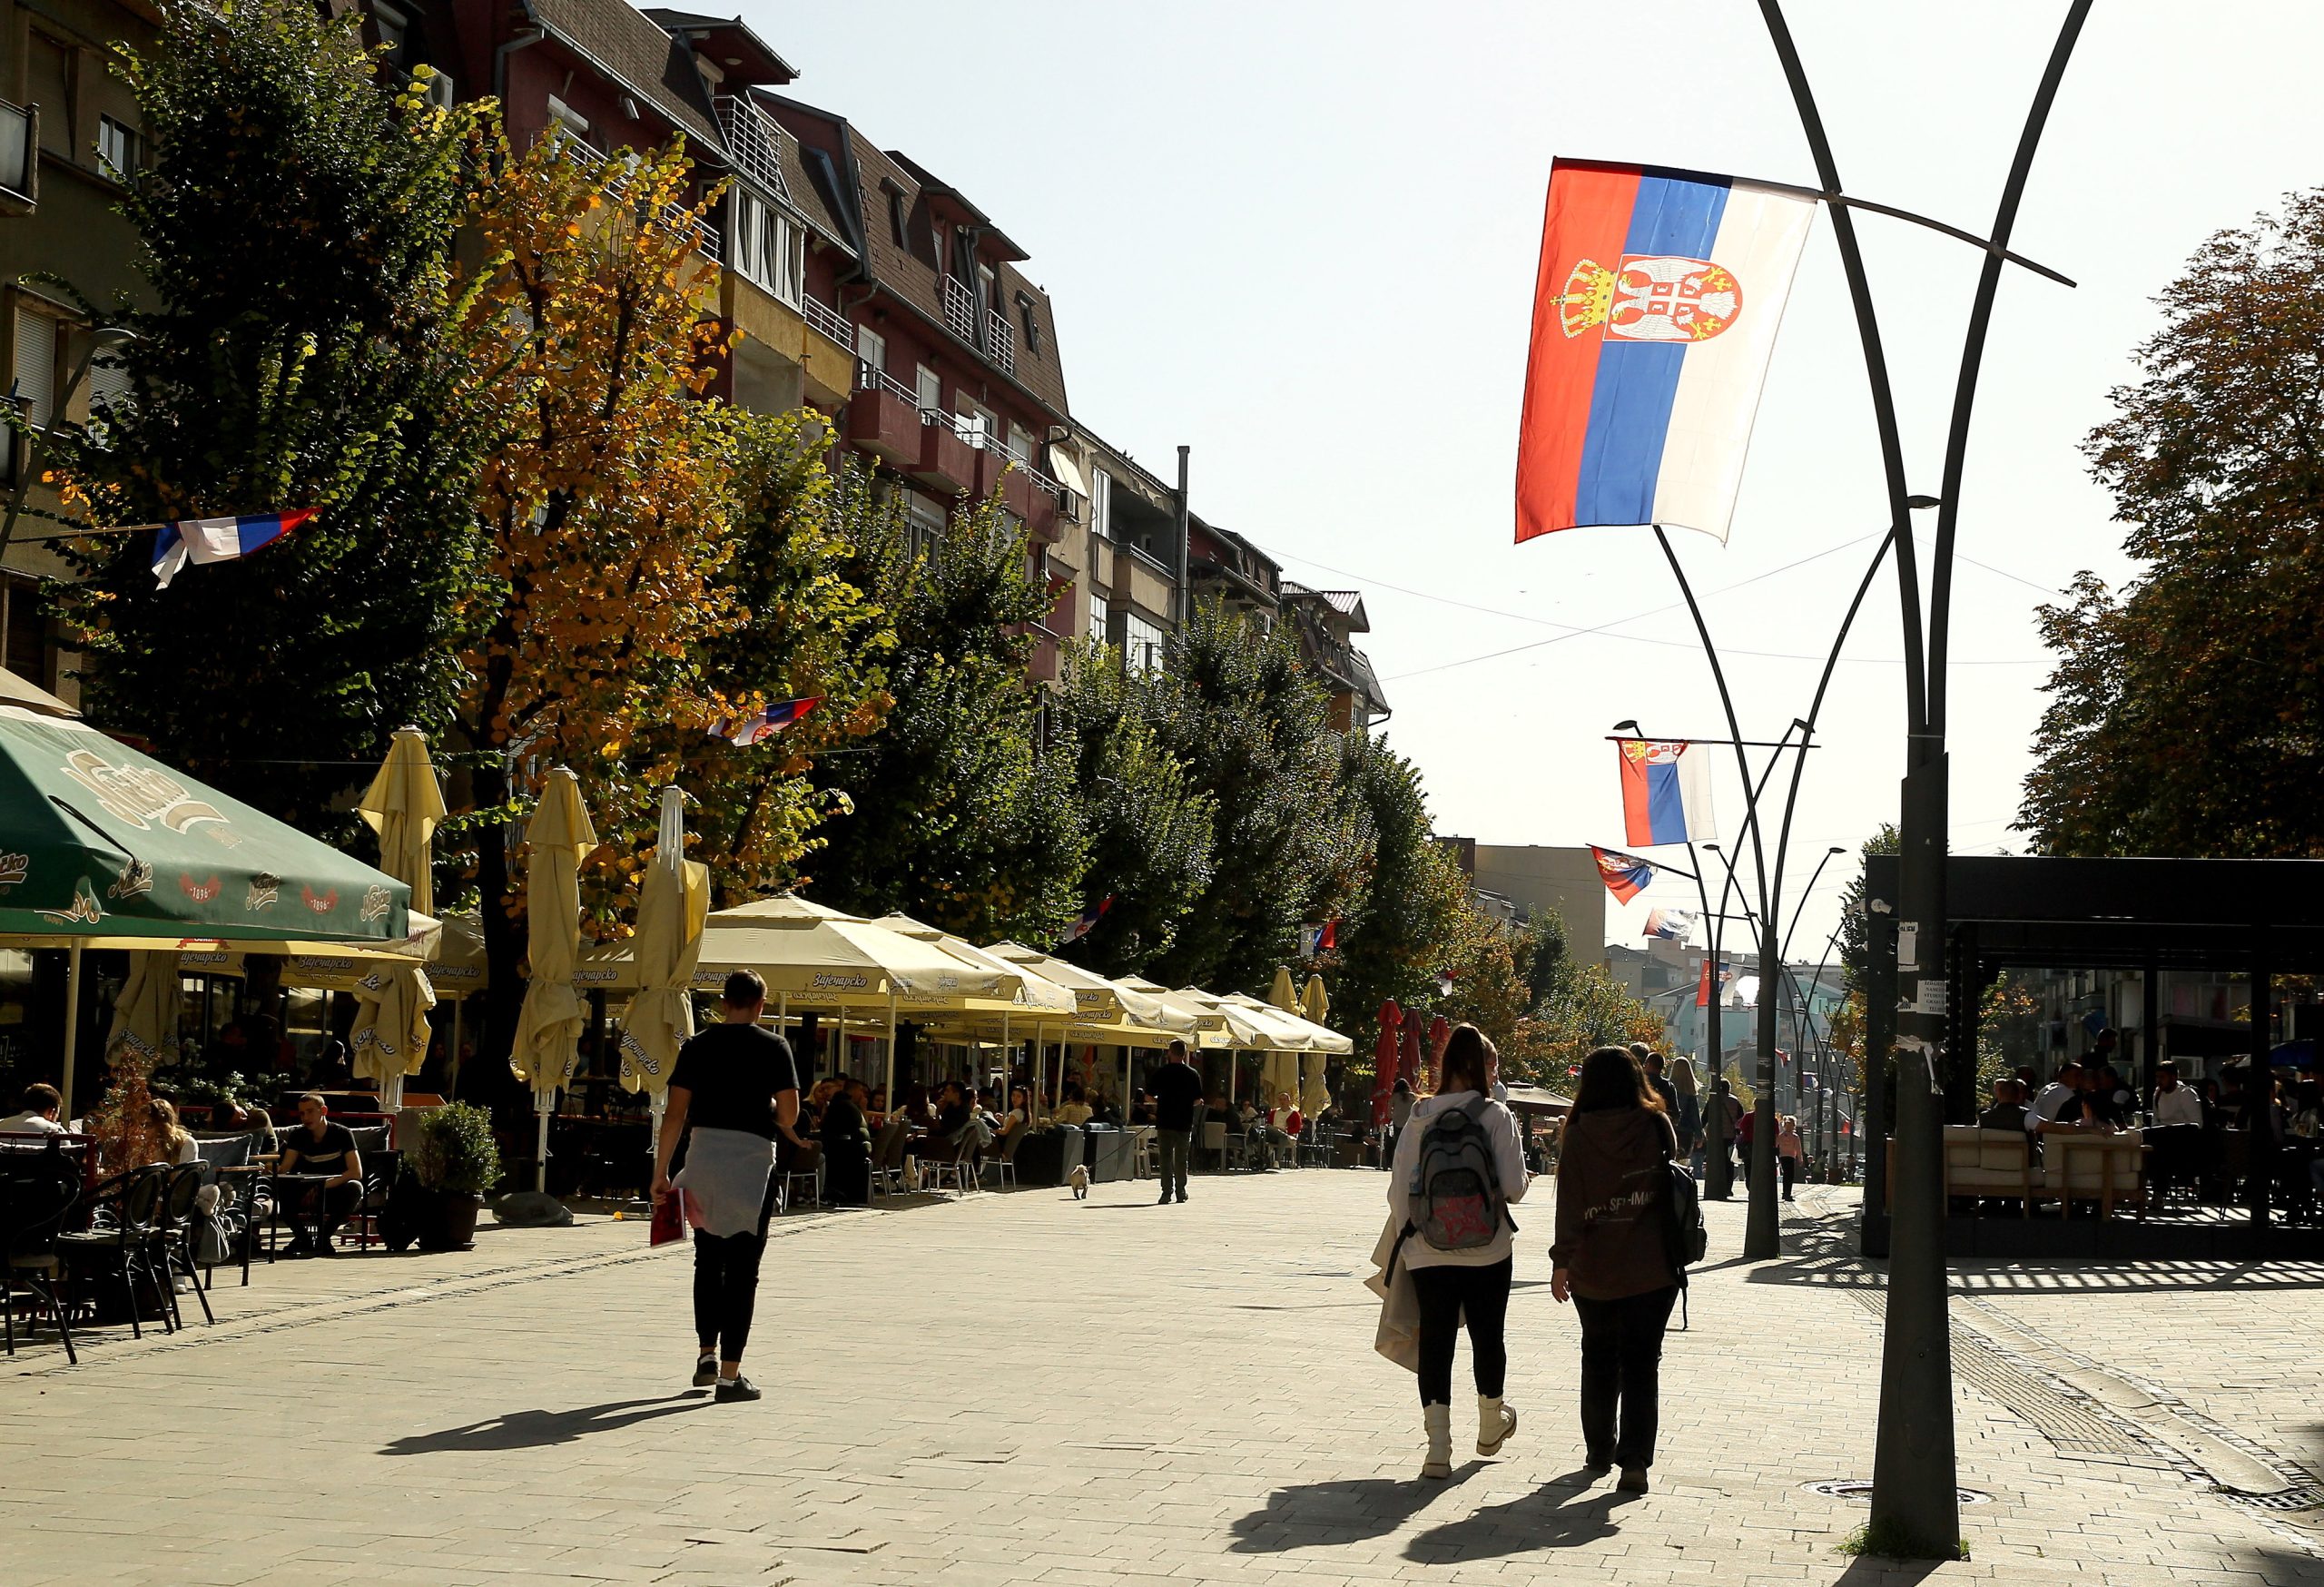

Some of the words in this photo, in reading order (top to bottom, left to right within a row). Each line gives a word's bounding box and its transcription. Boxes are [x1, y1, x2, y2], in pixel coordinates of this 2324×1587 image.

[181, 952, 227, 966] ајечарско
[299, 956, 352, 971] Зајечарско
[426, 962, 480, 980] Зајечарско
[573, 968, 618, 983] ајечарско
[813, 972, 868, 989] Зајечарско
